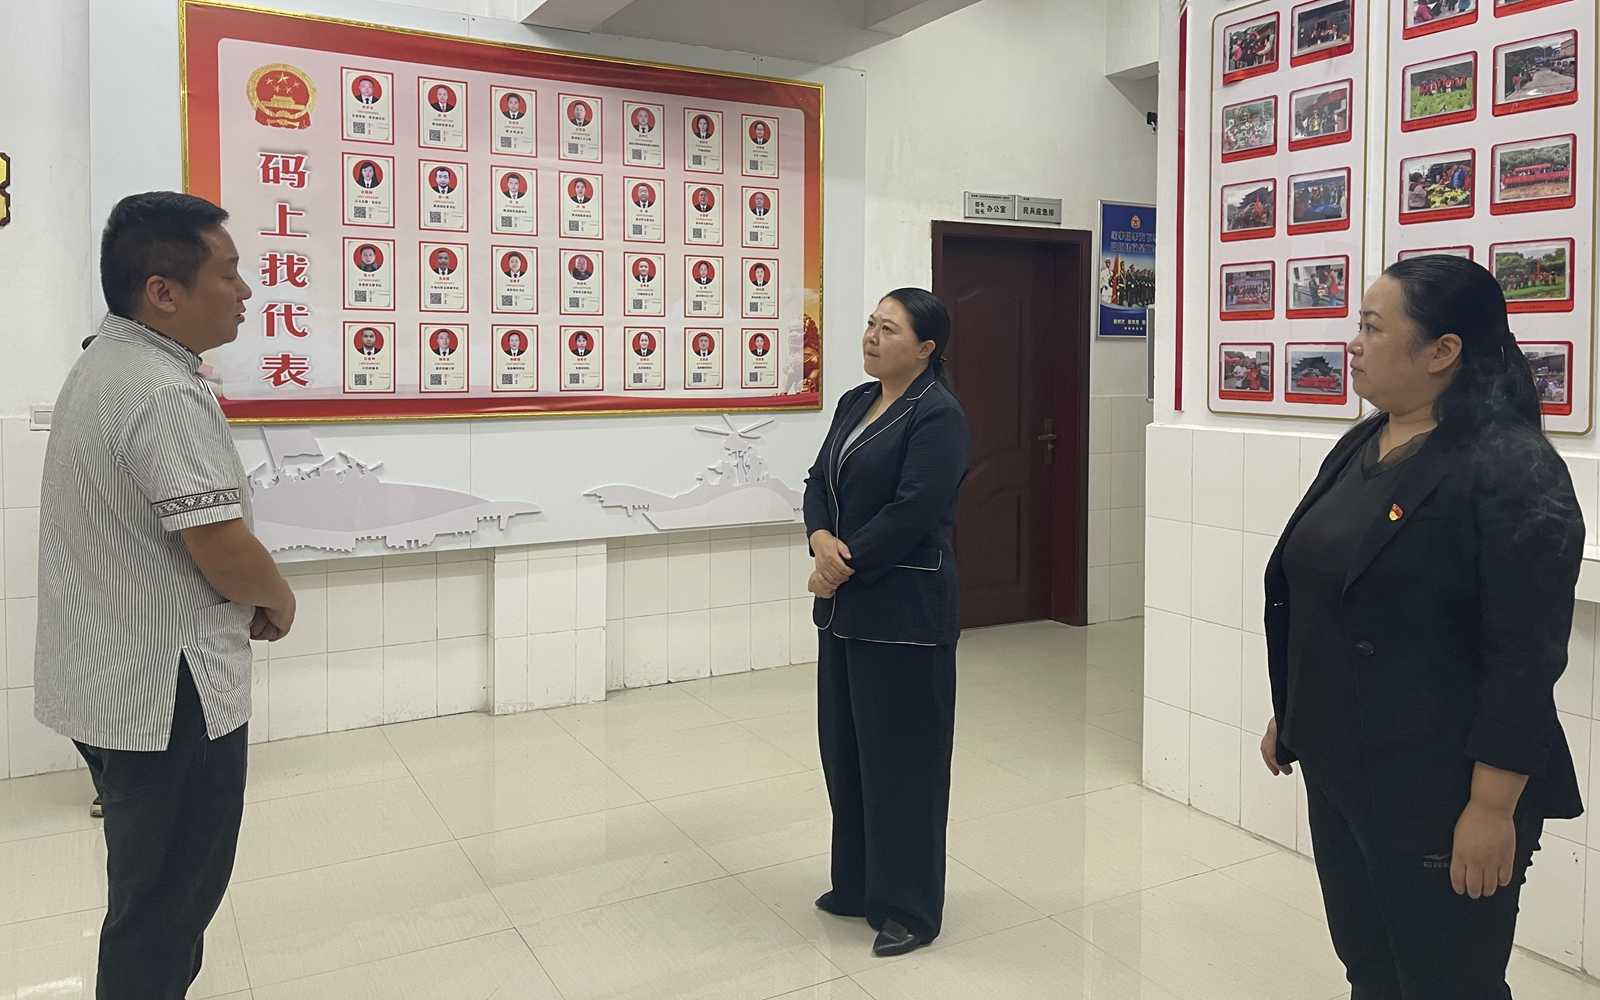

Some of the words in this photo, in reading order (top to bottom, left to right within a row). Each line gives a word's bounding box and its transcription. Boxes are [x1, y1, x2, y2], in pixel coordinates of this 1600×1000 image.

[259, 152, 309, 387] 码上找代表
